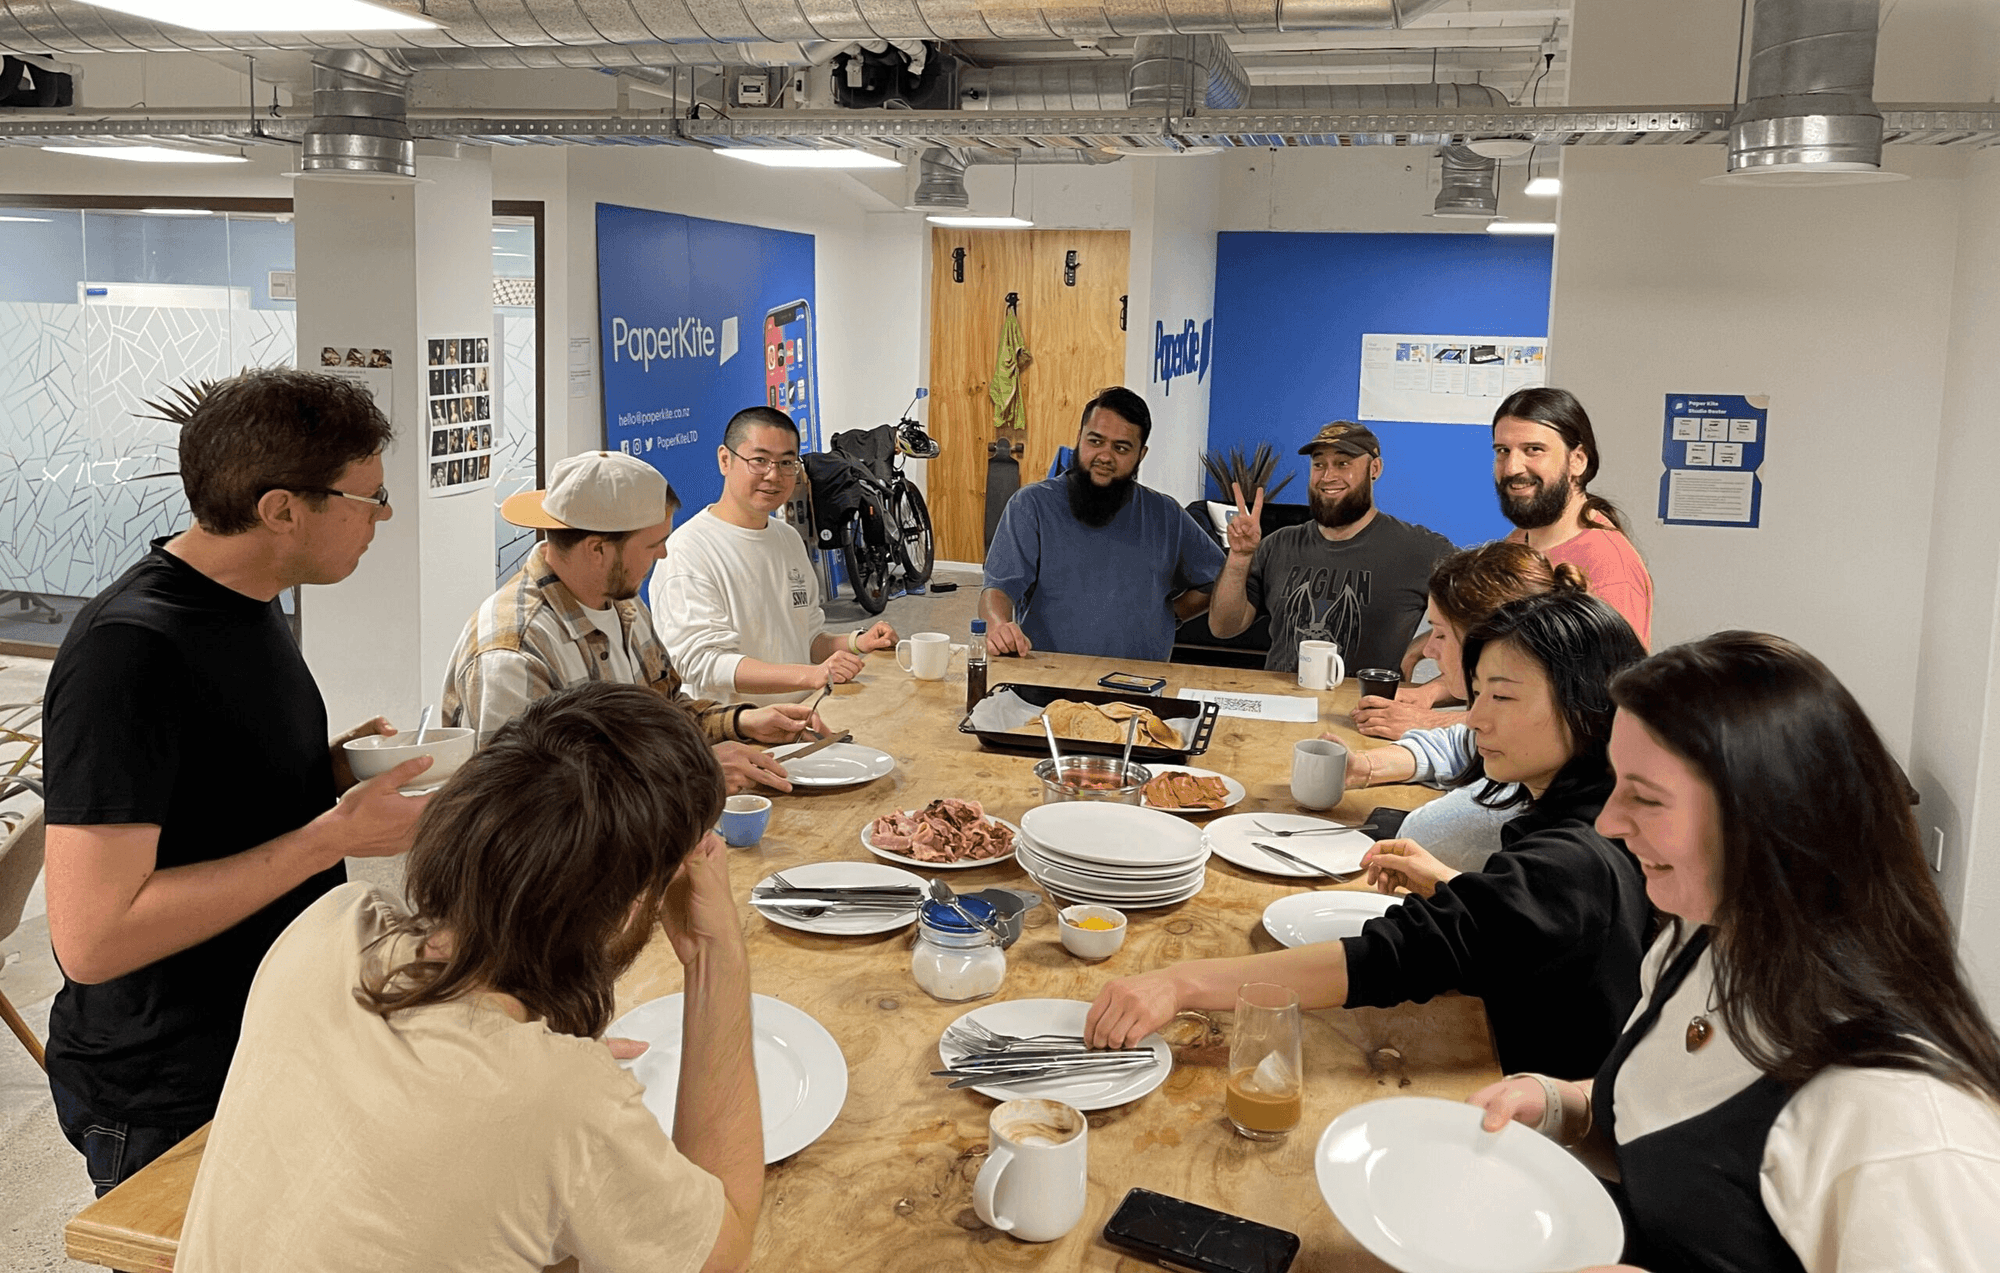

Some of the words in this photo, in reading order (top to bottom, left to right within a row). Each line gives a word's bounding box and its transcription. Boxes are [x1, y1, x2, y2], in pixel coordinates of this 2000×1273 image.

[612, 316, 715, 373] PaperKite
[1688, 400, 1706, 408] Paper
[618, 407, 690, 427] hello@paperkite.co.nz
[657, 430, 698, 450] PaperKiteLTD
[1281, 566, 1372, 605] RAGLAN
